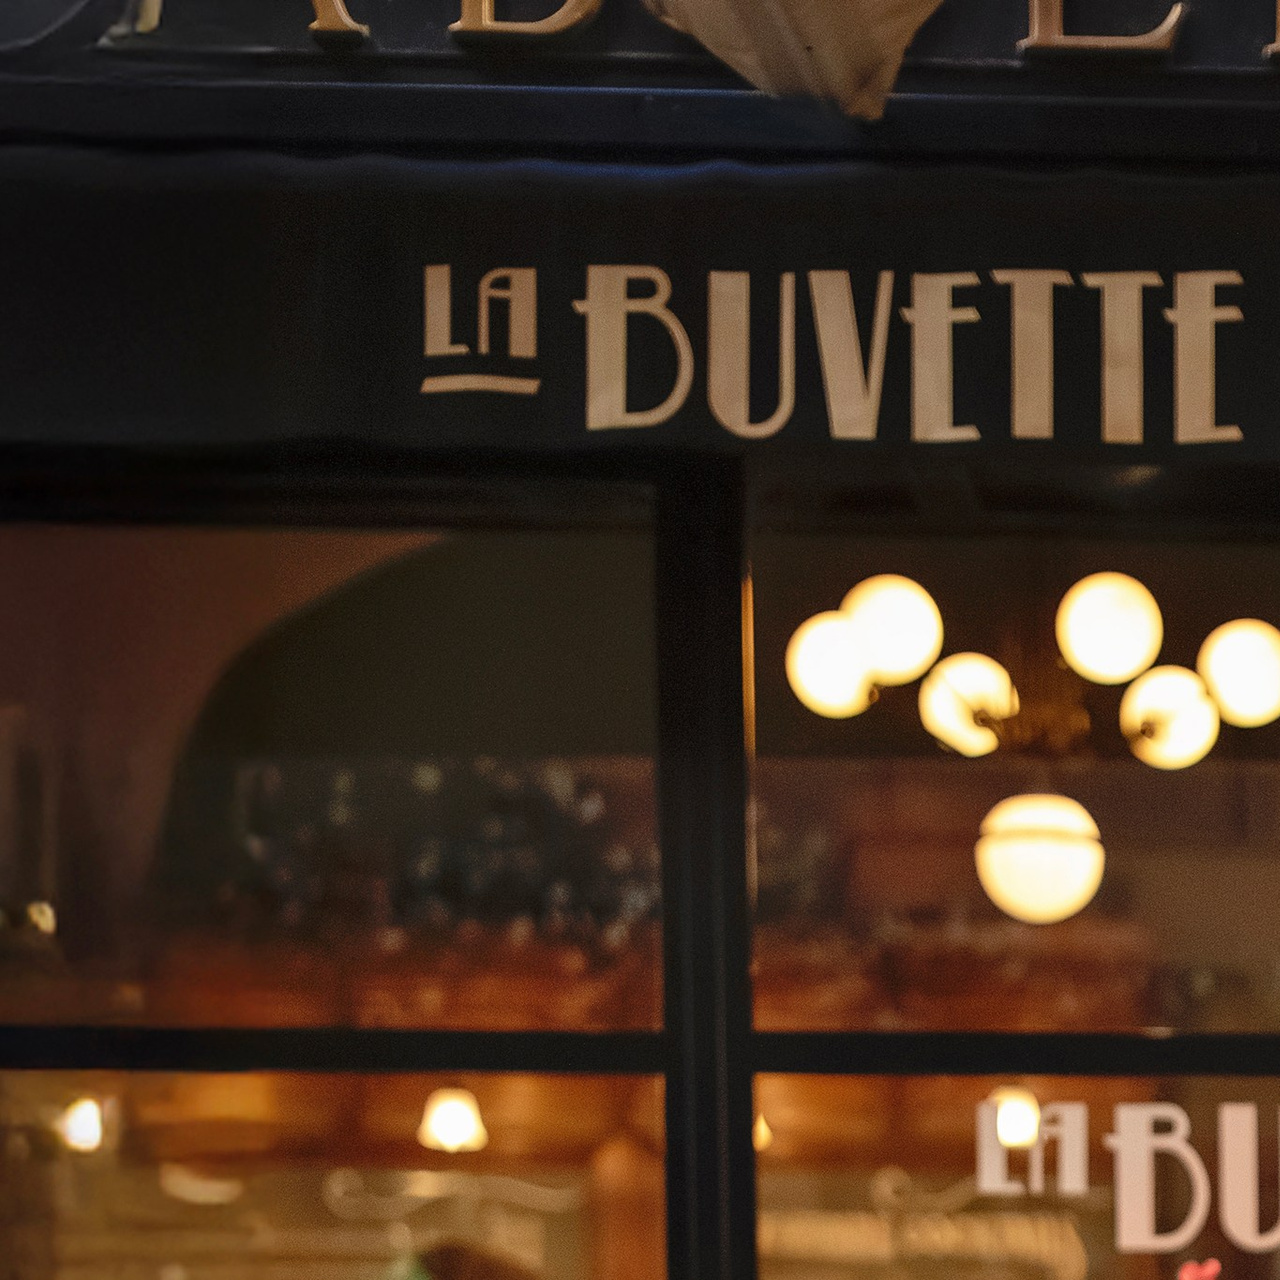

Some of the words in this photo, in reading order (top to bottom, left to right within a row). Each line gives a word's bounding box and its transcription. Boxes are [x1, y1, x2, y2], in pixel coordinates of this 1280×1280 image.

[423, 264, 539, 359] LA
[573, 264, 1244, 444] BUVETTE
[976, 1101, 1089, 1196] LA
